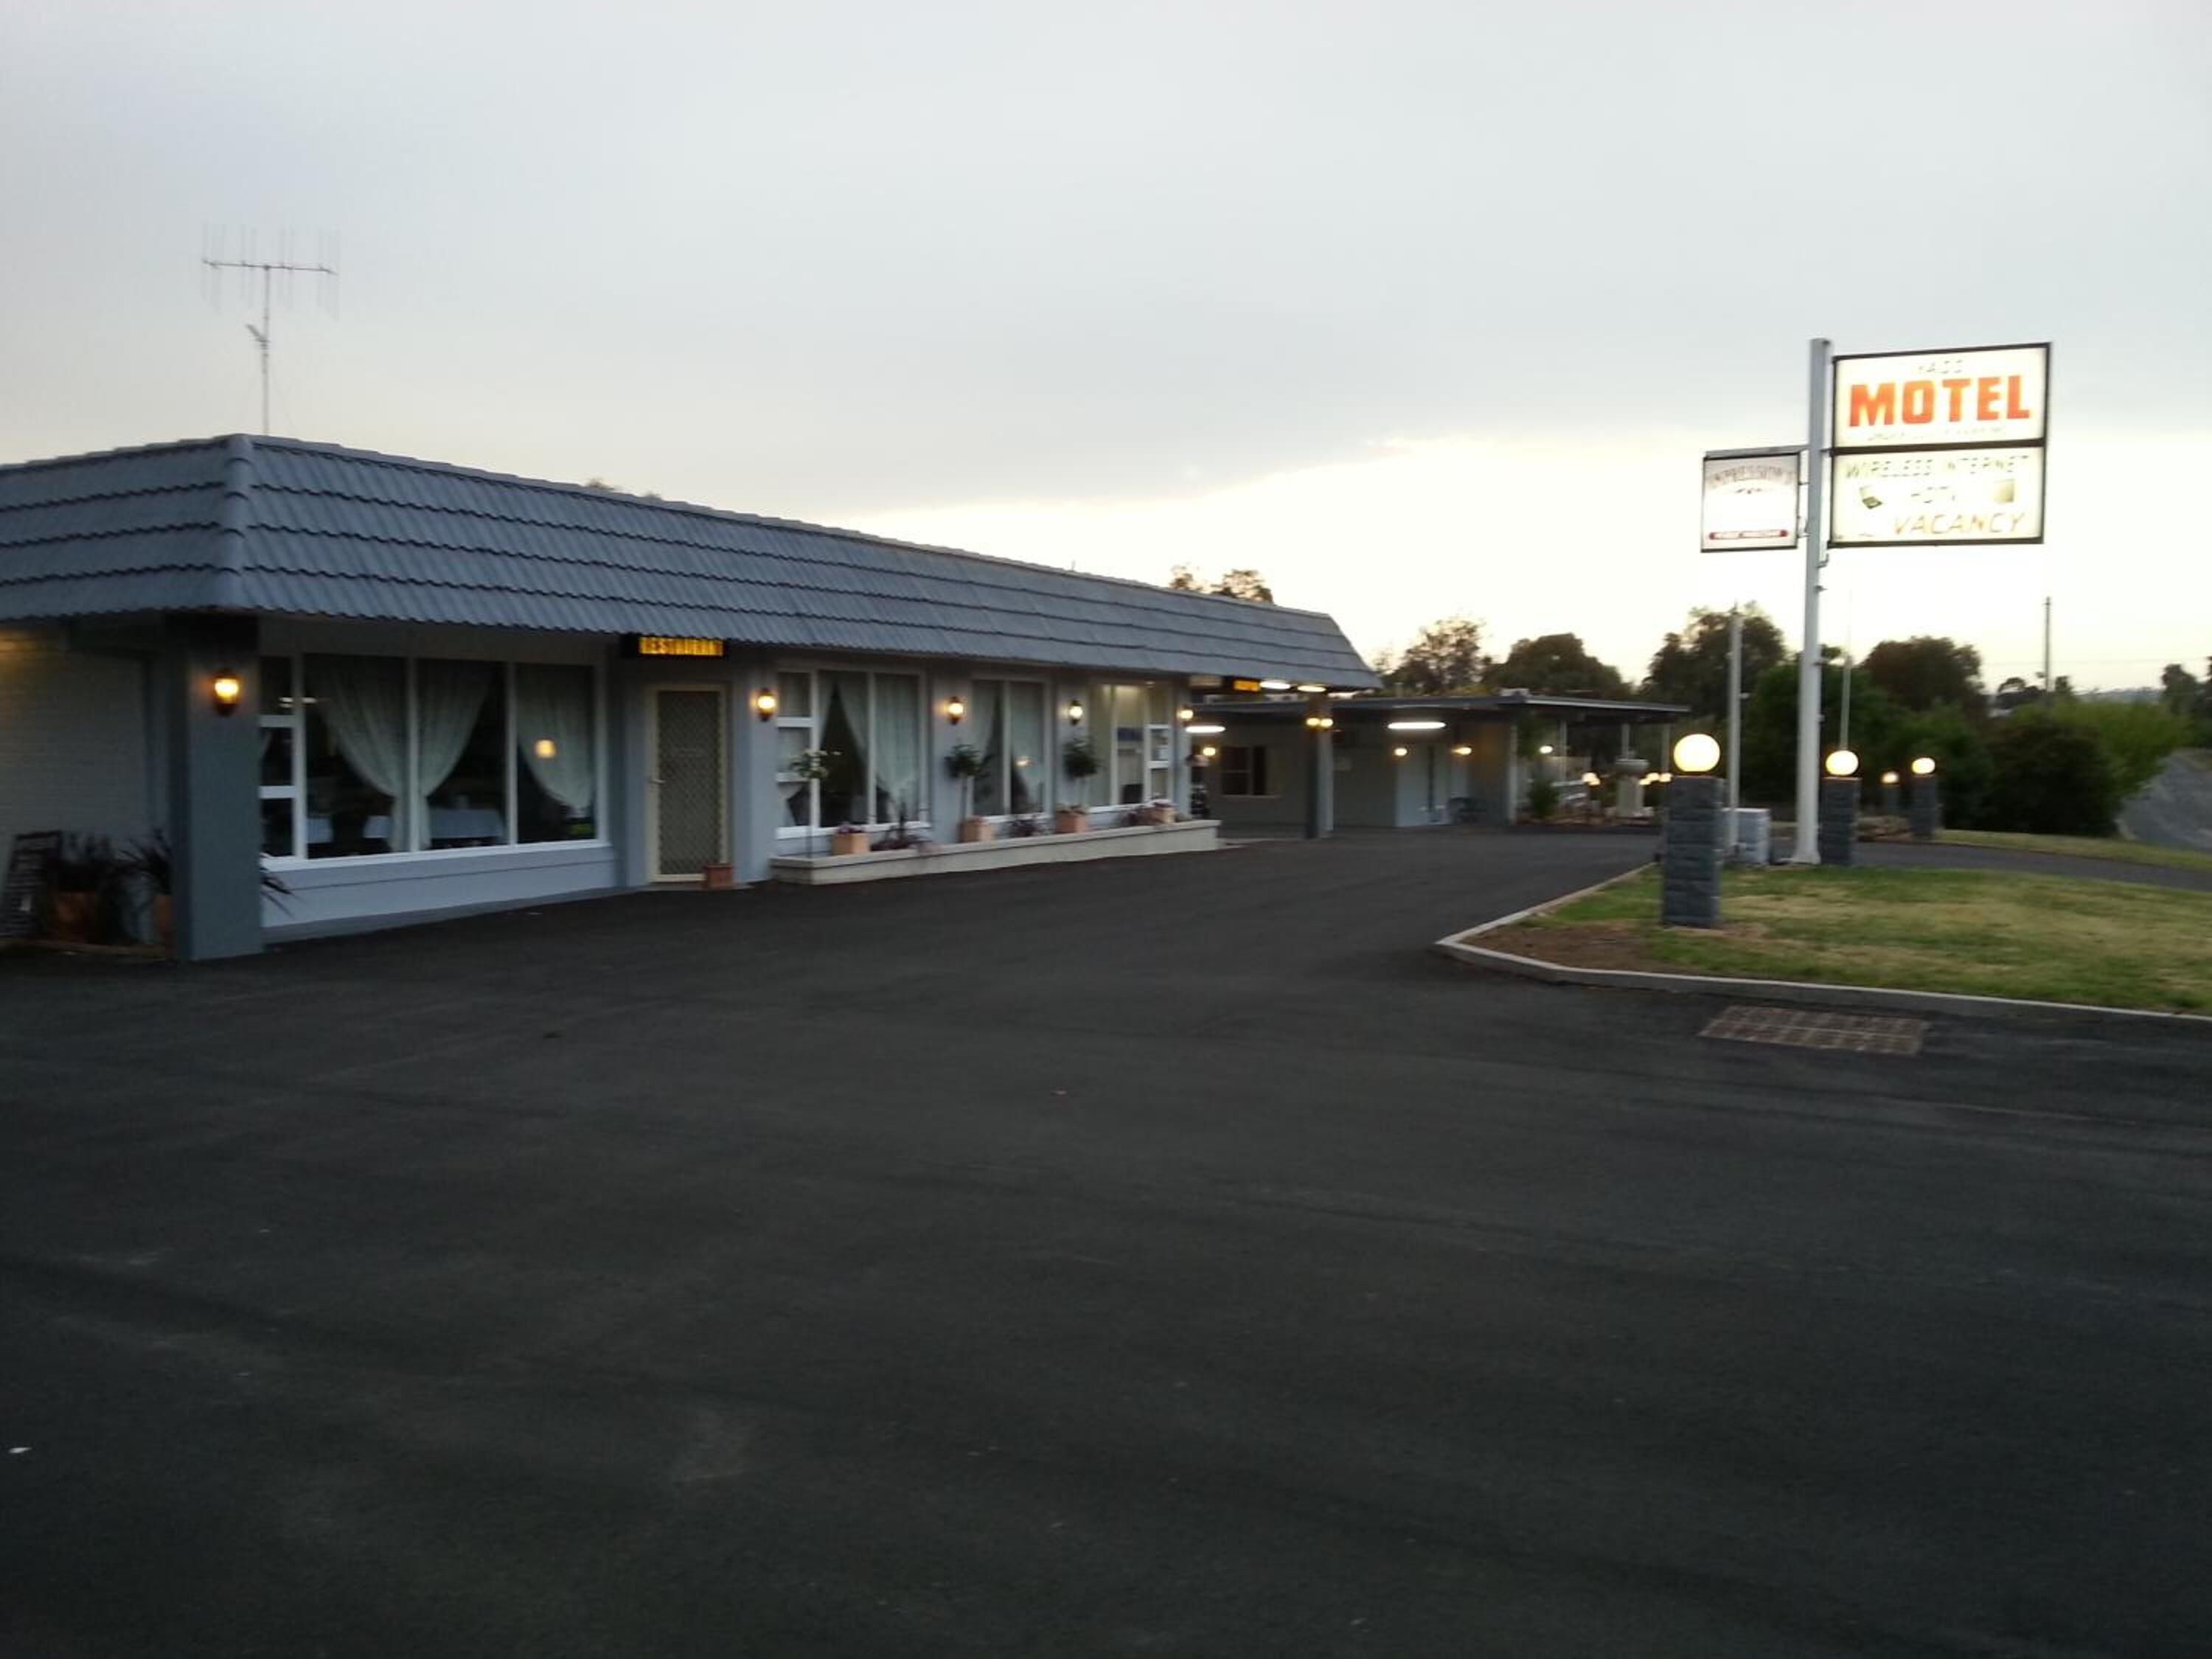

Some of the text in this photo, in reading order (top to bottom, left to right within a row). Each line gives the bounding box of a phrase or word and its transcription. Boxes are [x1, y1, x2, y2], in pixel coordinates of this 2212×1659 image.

[1849, 375, 2030, 427] MOTEL
[1846, 455, 2030, 479] WIRELESS NTERNET
[1893, 511, 2025, 535] VACANCY
